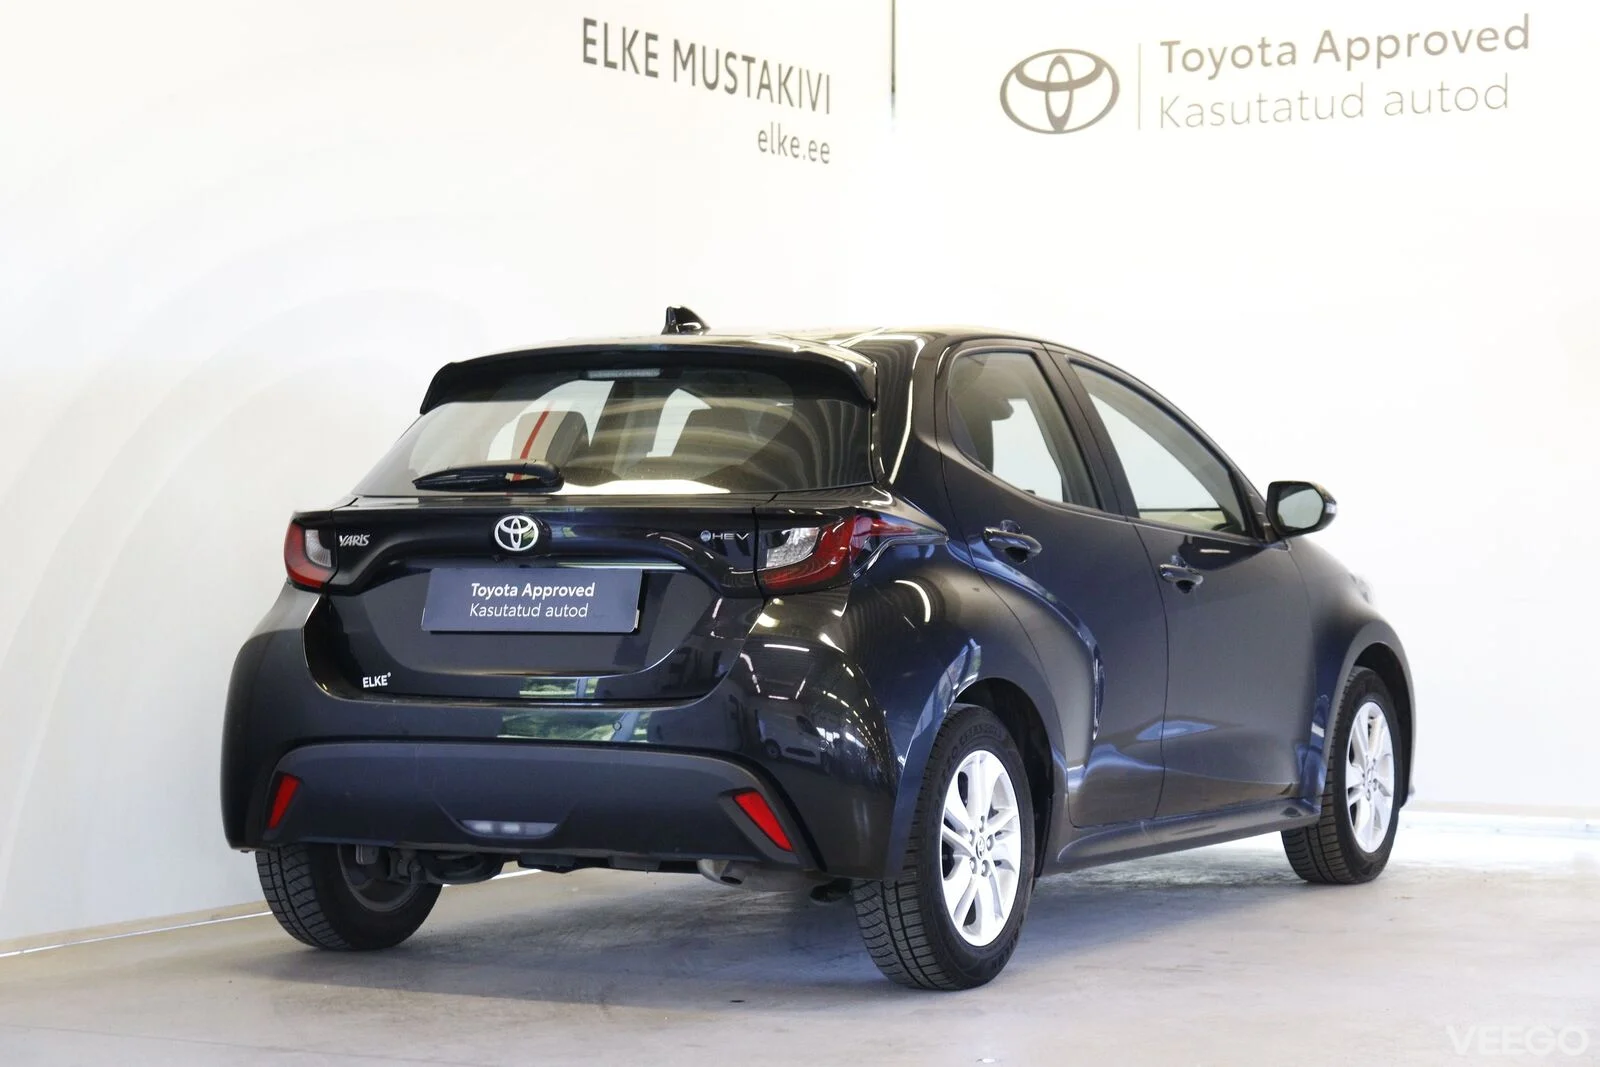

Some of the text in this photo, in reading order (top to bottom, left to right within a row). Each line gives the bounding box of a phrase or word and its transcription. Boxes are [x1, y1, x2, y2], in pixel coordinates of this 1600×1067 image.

[1160, 12, 1530, 81] Toyota Approved
[583, 17, 830, 115] ELKE MUSTAKIVI
[1160, 72, 1509, 129] Kasutatud autod
[757, 121, 830, 164] elke.ee
[339, 534, 370, 547] YARIS
[712, 532, 749, 541] HEV
[471, 582, 596, 600] Toyota Approved
[469, 602, 589, 618] Kasutatud autod
